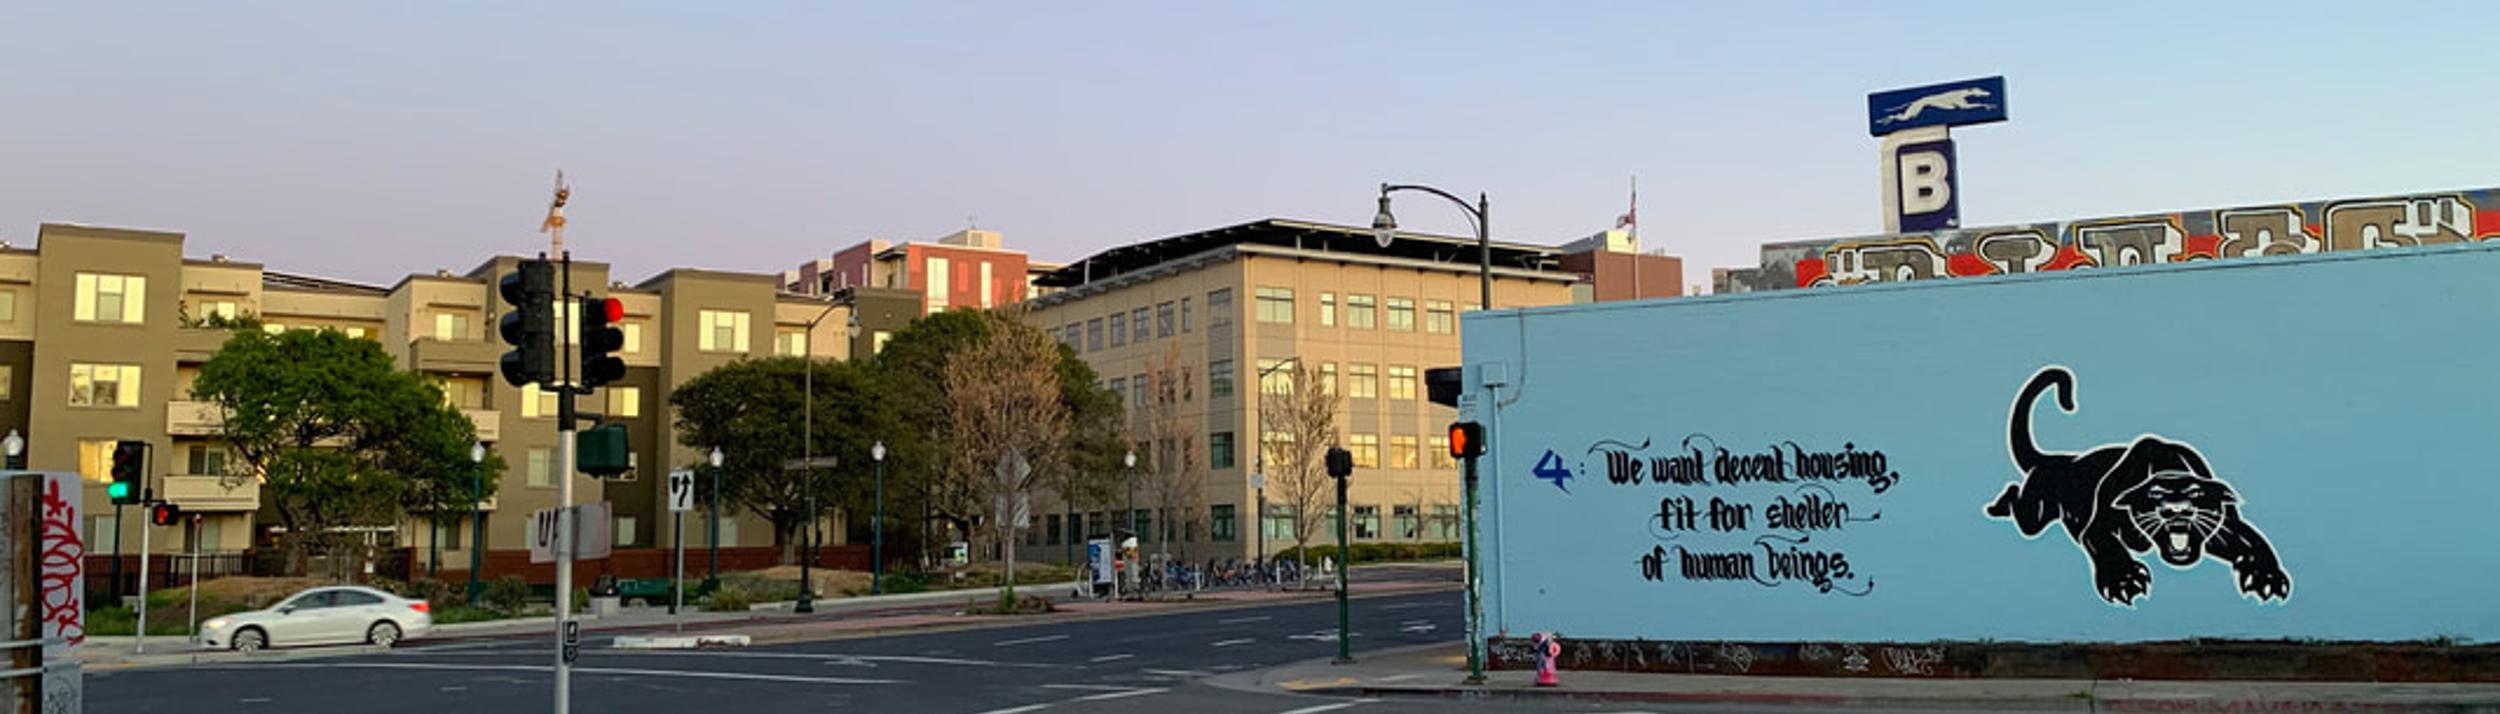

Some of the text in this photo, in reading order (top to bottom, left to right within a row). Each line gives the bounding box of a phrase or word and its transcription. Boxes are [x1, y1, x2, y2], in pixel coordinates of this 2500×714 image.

[1901, 150, 1951, 215] B
[1596, 440, 1648, 486] We
[1650, 440, 1712, 486] want
[1713, 446, 1796, 485] decent
[1785, 441, 1899, 494] housing,
[1655, 490, 1858, 533] fit for shelter
[1638, 537, 1862, 593] of human beings.
